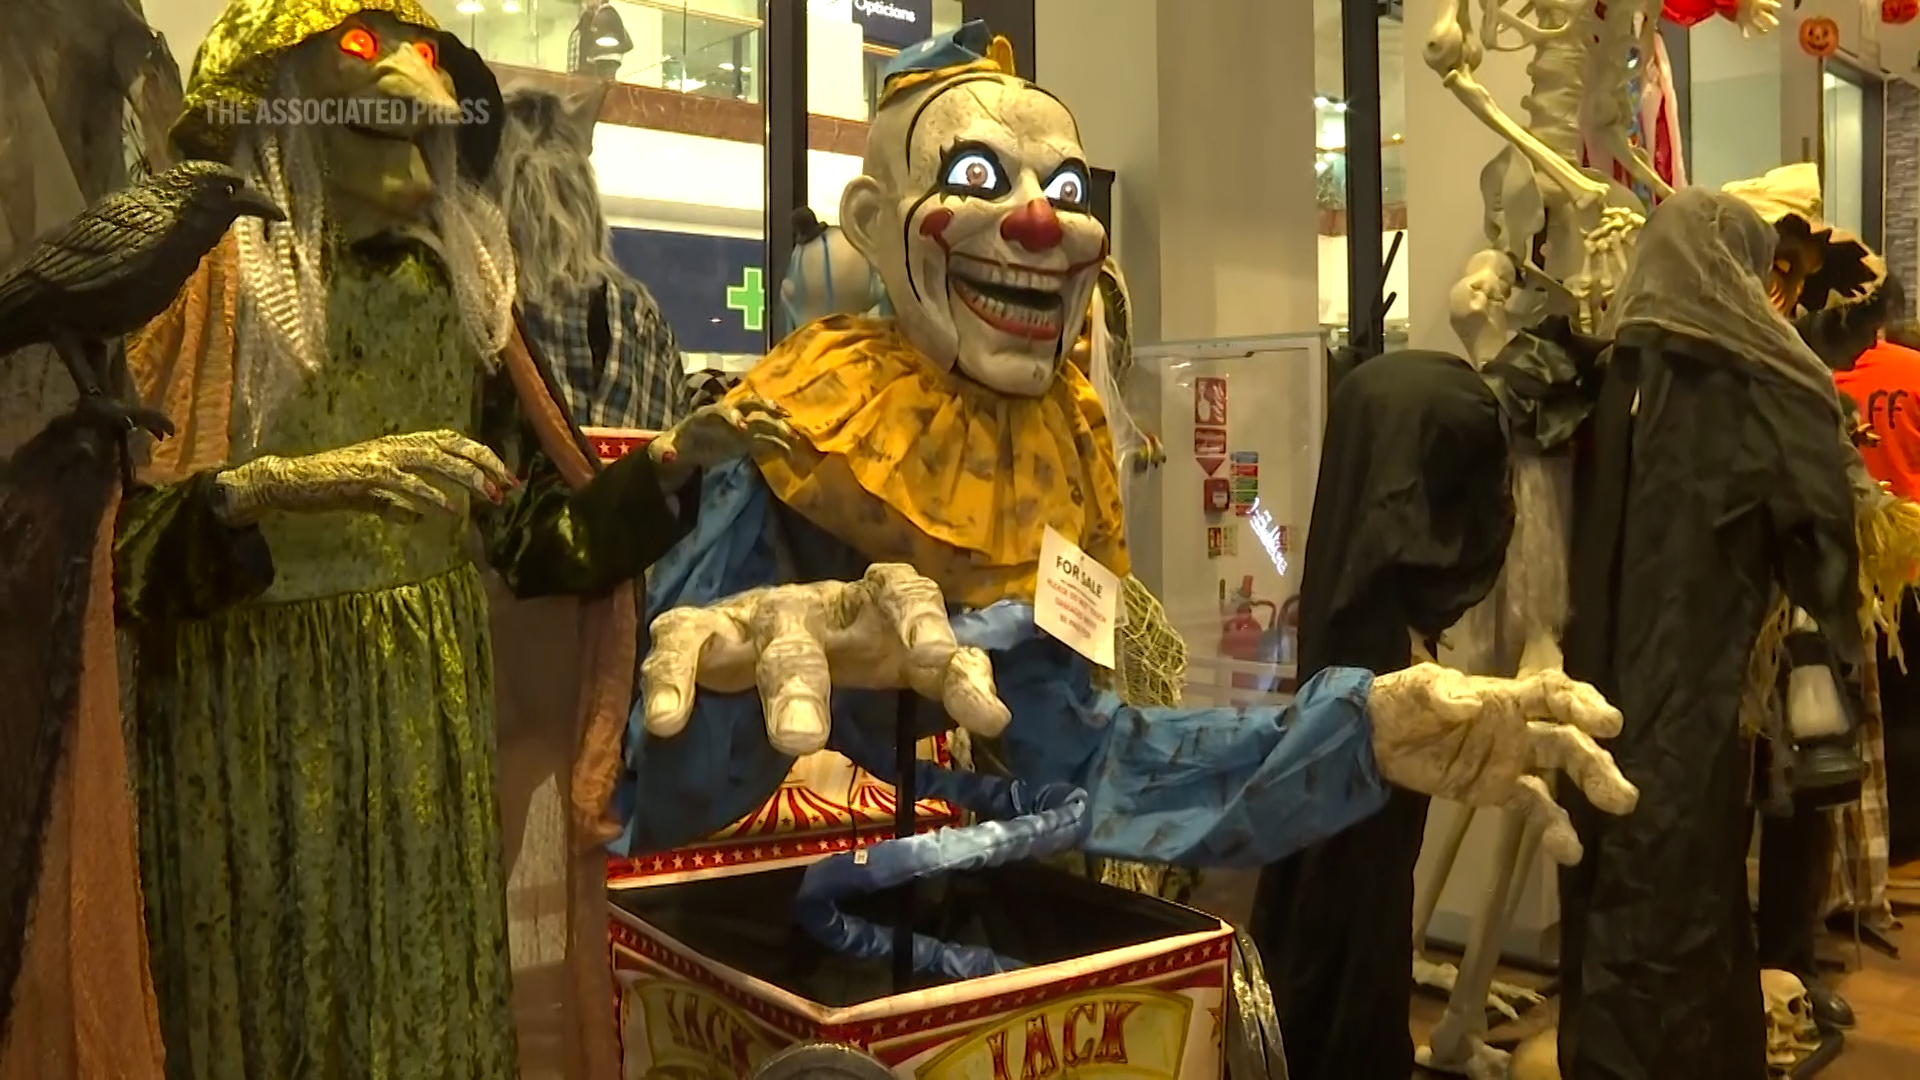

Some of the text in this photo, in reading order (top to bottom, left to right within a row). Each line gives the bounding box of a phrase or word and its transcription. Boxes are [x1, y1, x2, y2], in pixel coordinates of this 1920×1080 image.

[855, 0, 916, 23] Opticians
[1056, 555, 1103, 600] FOR SALE
[663, 987, 753, 1080] JACK
